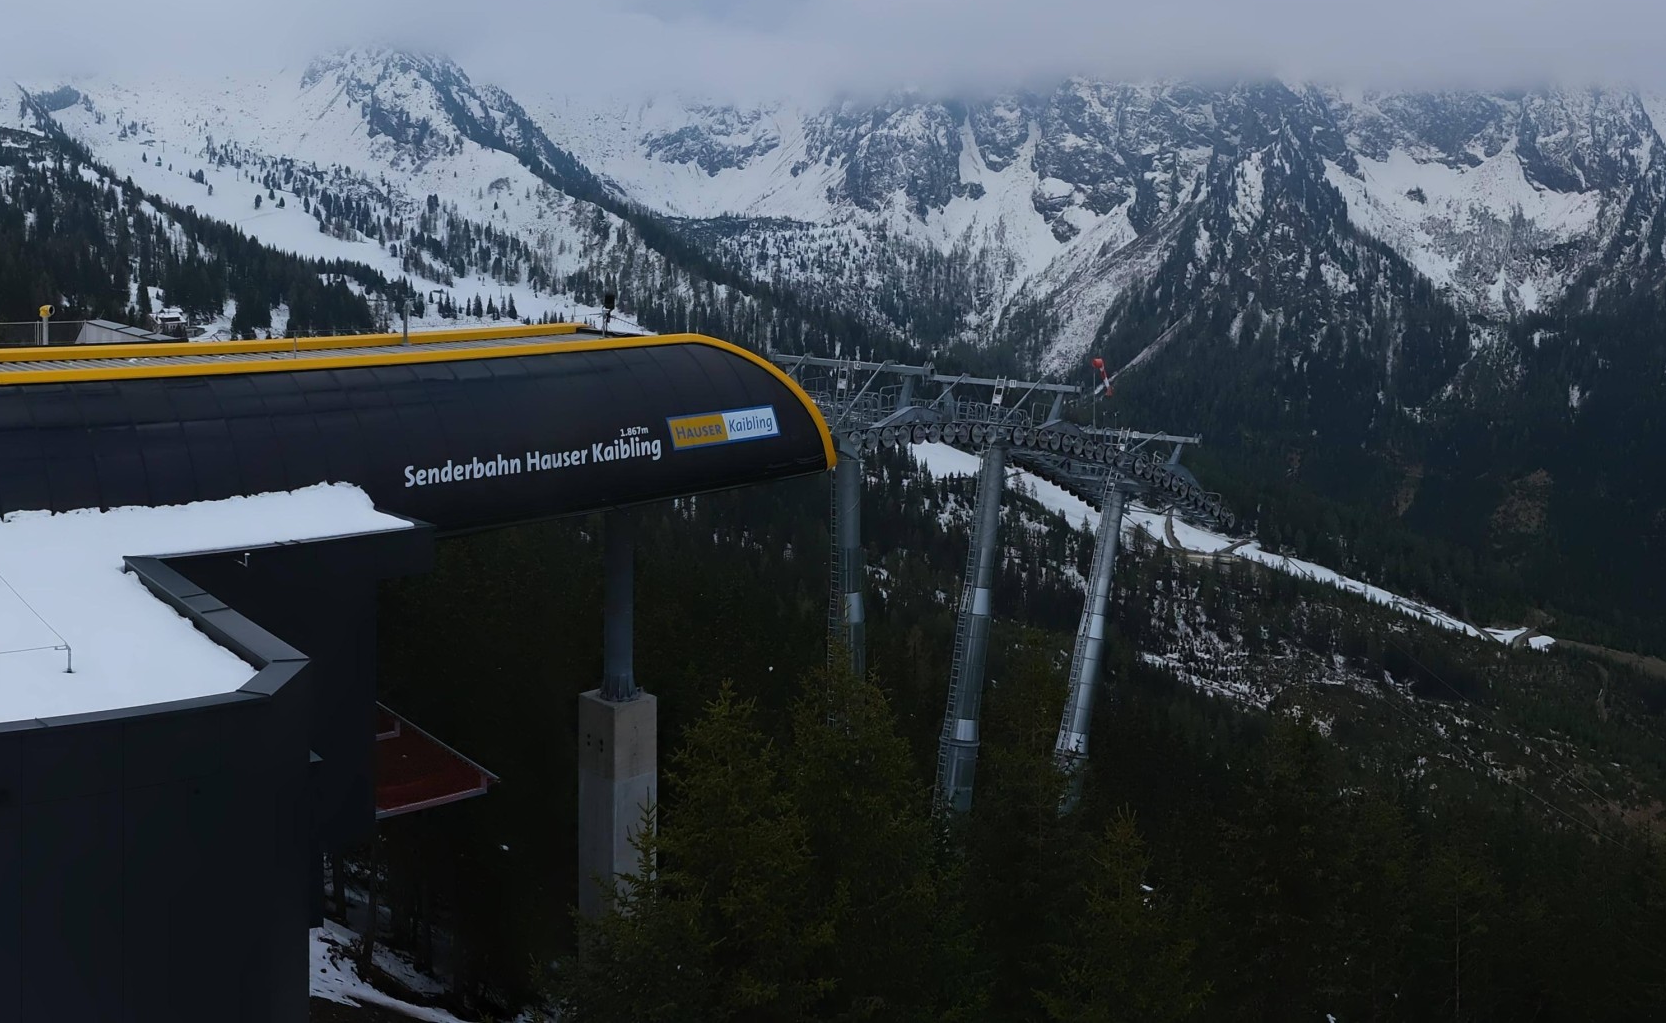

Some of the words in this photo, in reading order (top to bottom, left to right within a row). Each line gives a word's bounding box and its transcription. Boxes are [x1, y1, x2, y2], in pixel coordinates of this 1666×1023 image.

[619, 426, 650, 438] 1.867m
[674, 423, 724, 440] HAUSER
[728, 415, 774, 434] Kaibling
[404, 454, 522, 488] Senderbahn
[526, 447, 588, 472] Hauser
[592, 437, 662, 464] Kaibling
